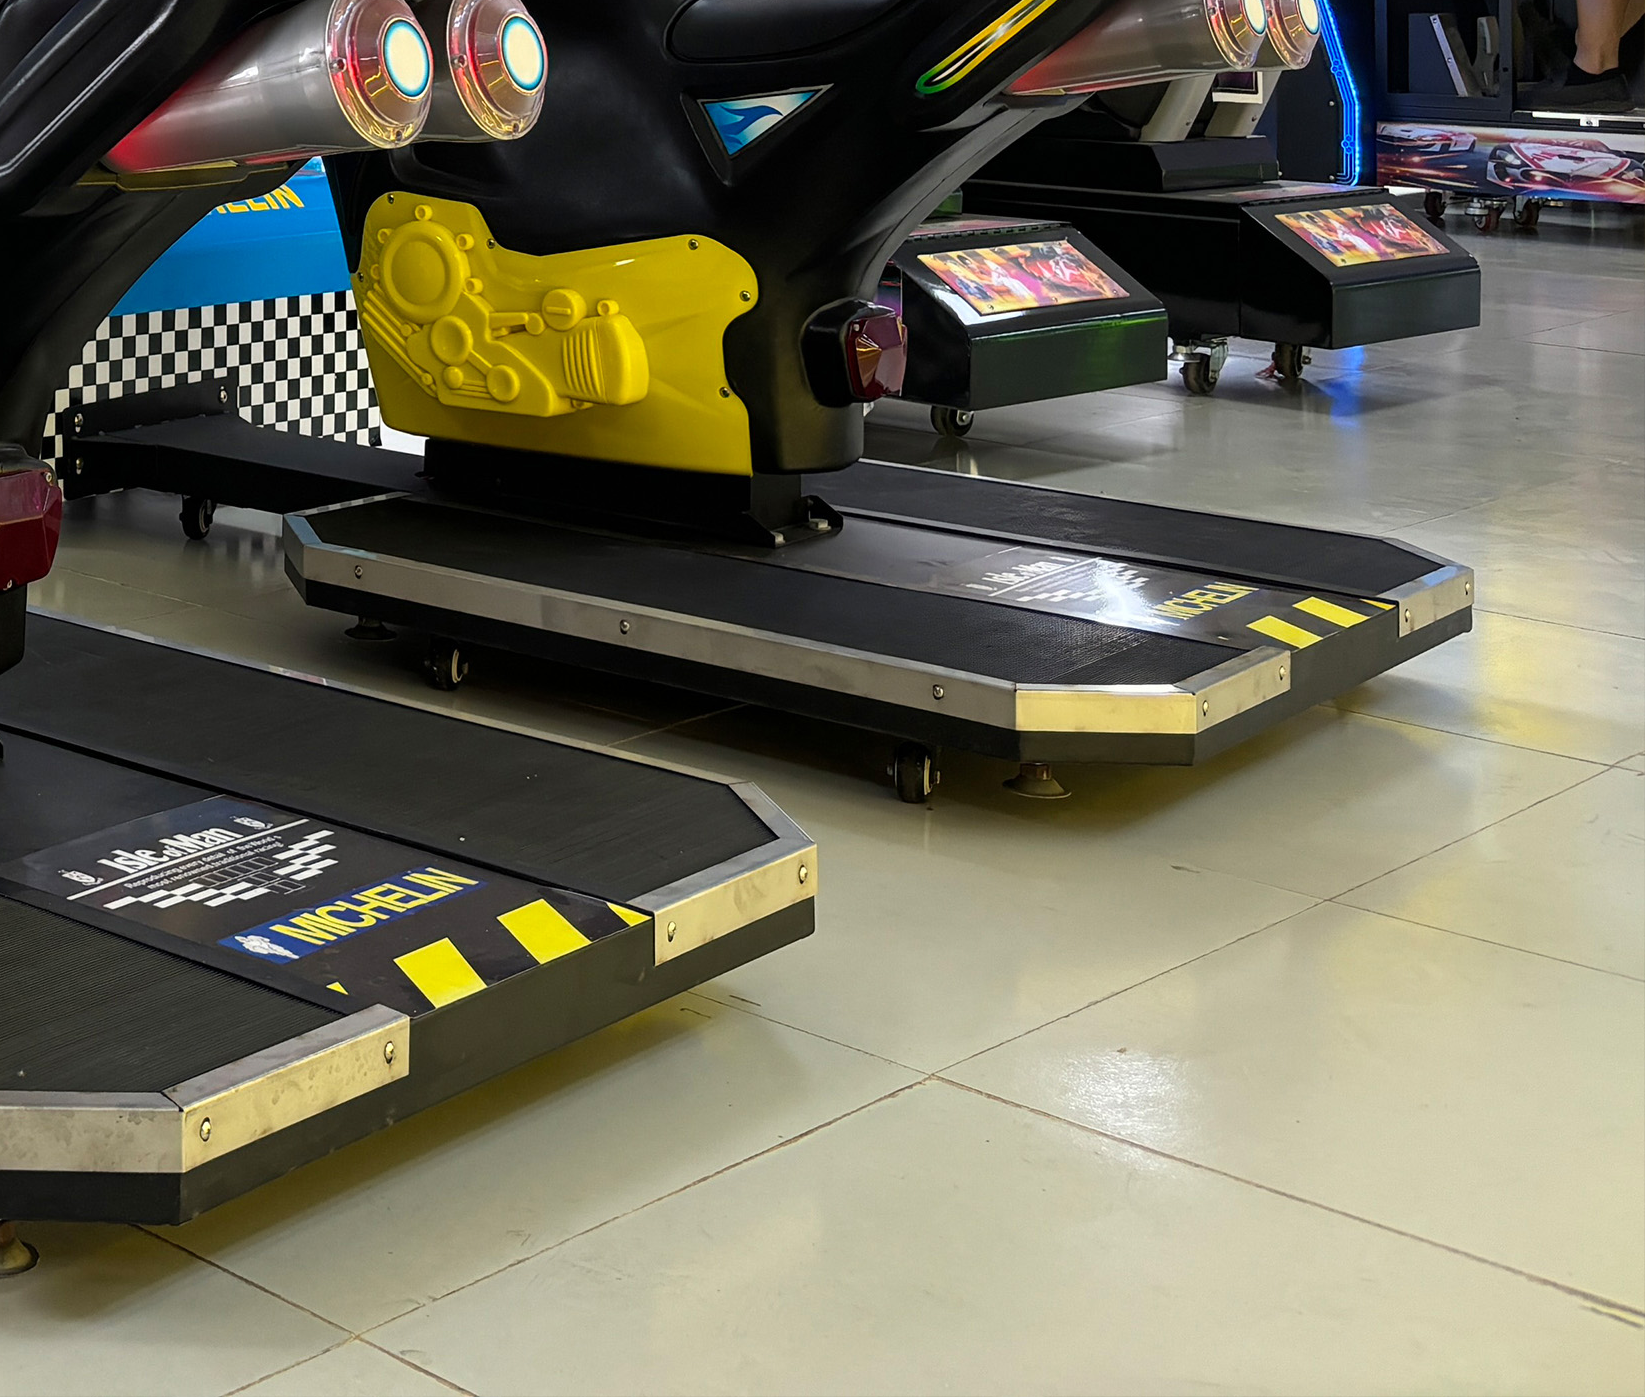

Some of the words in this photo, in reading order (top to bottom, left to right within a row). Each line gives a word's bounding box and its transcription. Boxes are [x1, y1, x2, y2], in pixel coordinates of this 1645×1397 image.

[97, 849, 169, 873] Isle
[159, 828, 244, 854] Man
[271, 866, 480, 945] MICHELIN
